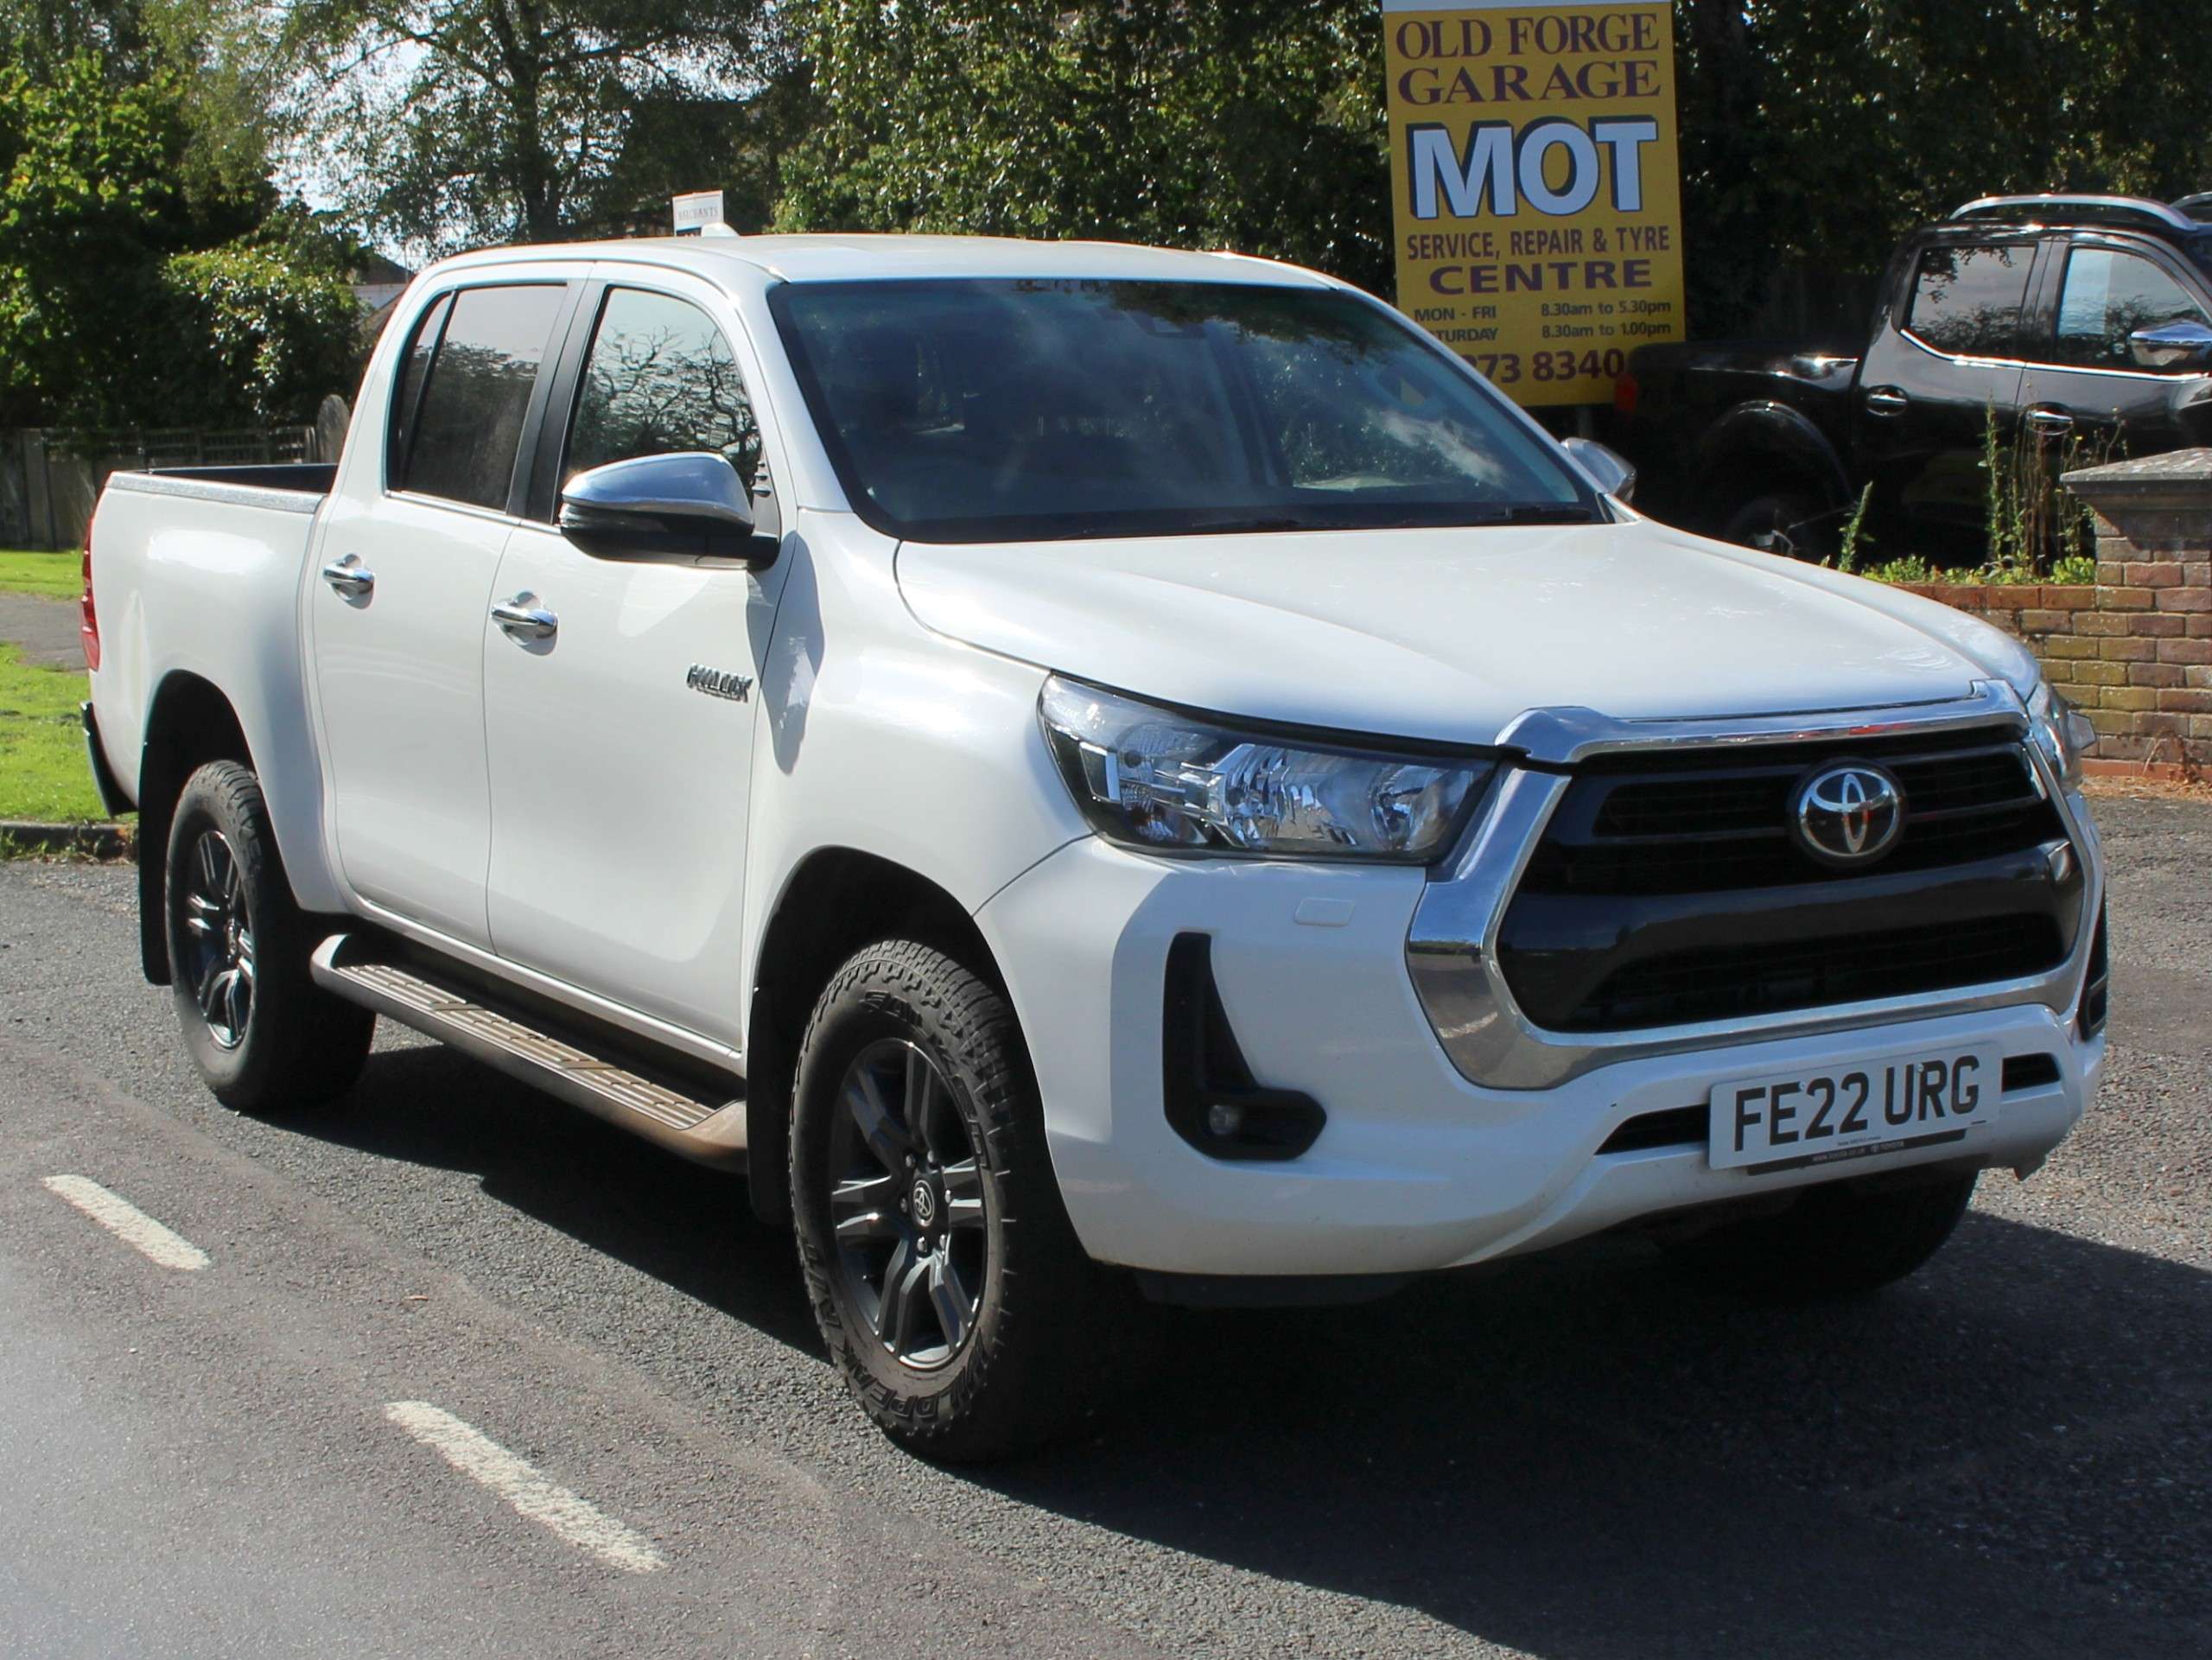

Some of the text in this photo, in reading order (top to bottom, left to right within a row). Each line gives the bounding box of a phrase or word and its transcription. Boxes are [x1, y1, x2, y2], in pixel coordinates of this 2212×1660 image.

[1396, 12, 1659, 60] OLD FORGE
[1398, 60, 1662, 105] GARAGE
[1407, 115, 1658, 219] MOT
[1408, 226, 1669, 260] SERVICE, REPAIR & TYRE
[1429, 259, 1652, 296] CENTRE
[1414, 307, 1454, 321] MON
[1473, 306, 1497, 319] FRI
[1541, 302, 1592, 316] 8.30am
[1599, 302, 1614, 315] to
[1619, 301, 1671, 316] 5.30pm
[1541, 324, 1593, 338] 8.30am
[1599, 324, 1614, 336] to
[1621, 322, 1671, 338] 1.00pm
[1734, 1055, 1980, 1151] FE22 URG
